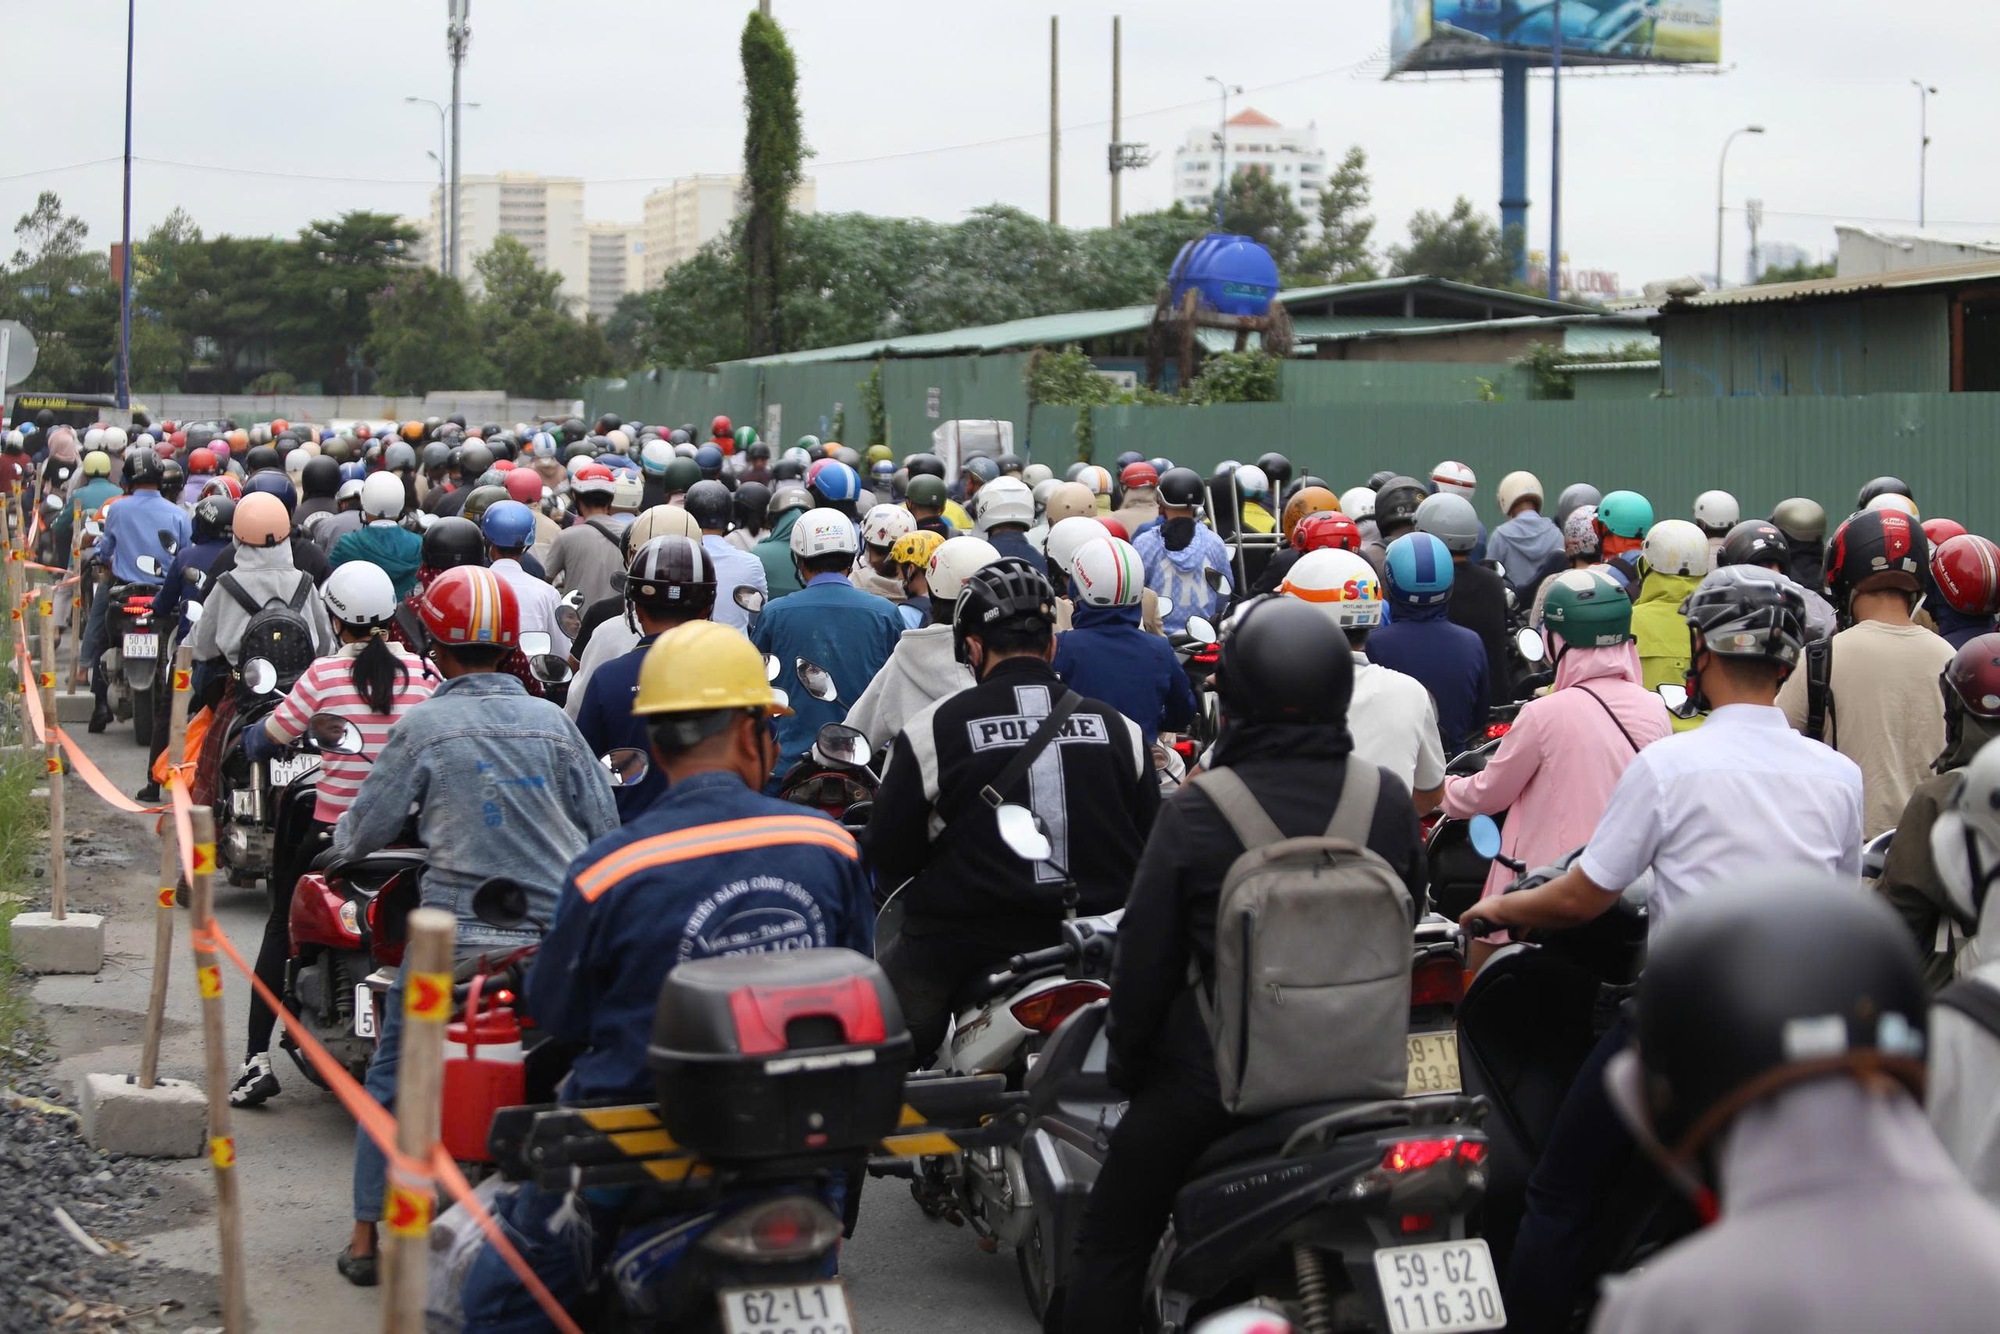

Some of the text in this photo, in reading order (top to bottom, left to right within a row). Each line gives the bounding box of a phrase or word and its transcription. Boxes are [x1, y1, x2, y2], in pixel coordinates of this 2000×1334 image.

[980, 718, 1096, 744] POLME
[1394, 1248, 1478, 1288] 59-G2
[742, 1285, 830, 1325] 62-L1
[1394, 1287, 1496, 1329] 116.30
